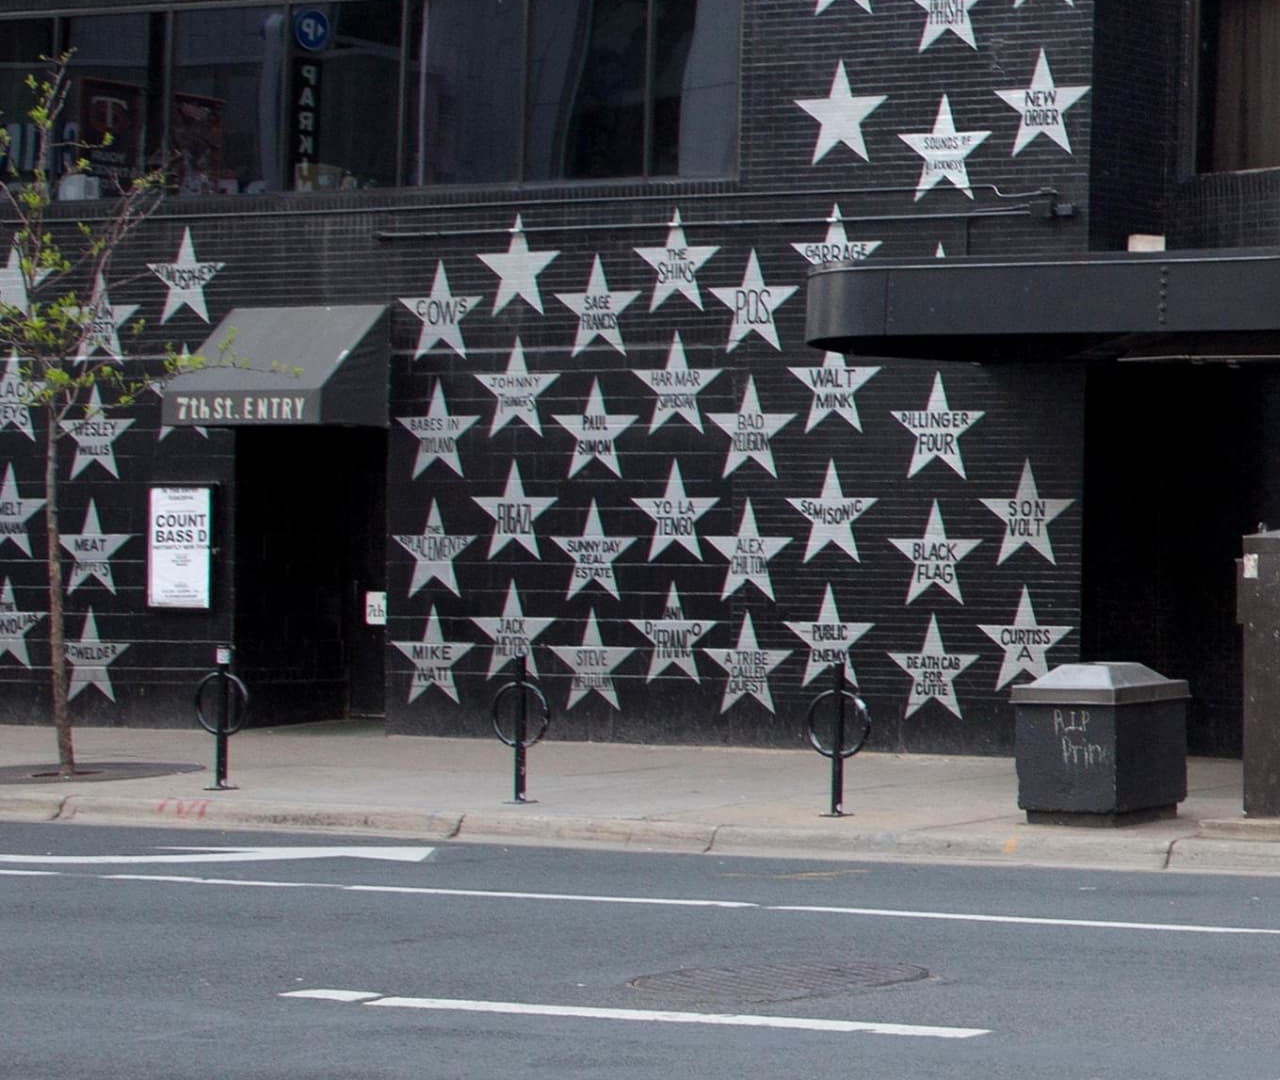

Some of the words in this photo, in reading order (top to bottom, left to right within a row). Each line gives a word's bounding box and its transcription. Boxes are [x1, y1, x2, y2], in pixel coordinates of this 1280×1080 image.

[1024, 90, 1057, 108] NEW
[1024, 109, 1059, 127] ORDER
[666, 248, 688, 262] THE
[657, 261, 697, 285] SHINS
[583, 295, 613, 311] SAGE
[416, 298, 468, 326] COWS
[580, 313, 618, 332] FRANCIS
[489, 375, 542, 389] JOHNNY
[650, 371, 673, 388] HAR
[674, 370, 701, 387] MAR
[809, 368, 857, 388] WALT
[176, 397, 211, 420] 7th
[213, 397, 240, 420] St.
[243, 397, 305, 420] ENTRY
[815, 394, 853, 410] MINK
[0, 405, 30, 427] EYS
[409, 417, 444, 432] BABES
[447, 417, 460, 431] IN
[581, 415, 606, 432] PAUL
[736, 413, 765, 431] BAD
[901, 411, 970, 429] DILLINGER
[72, 421, 118, 438] WESLEY
[577, 439, 613, 457] SIMON
[918, 433, 956, 455] FOUR
[653, 501, 672, 515] YO
[678, 501, 696, 515] LA
[800, 499, 864, 526] SEMISONIC
[1008, 500, 1046, 518] SON
[155, 514, 207, 529] COUNT
[656, 517, 694, 537] TENGO
[1008, 518, 1045, 538] VOLT
[155, 529, 194, 544] BASS
[198, 529, 208, 543] D
[75, 538, 108, 553] MEAT
[567, 539, 600, 555] SUNNY
[602, 539, 622, 555] DAY
[735, 538, 765, 554] ALEX
[912, 542, 957, 562] BLACK
[580, 553, 606, 565] REAL
[731, 557, 768, 576] CHILTON
[575, 566, 613, 580] ESTATE
[917, 562, 954, 584] FLAG
[496, 620, 526, 636] JACK
[811, 623, 849, 641] PUBLIC
[1000, 629, 1051, 647] CURTISS
[412, 644, 453, 660] MIKE
[575, 649, 609, 667] STEVE
[724, 653, 734, 667] A
[735, 651, 769, 666] TRIBE
[811, 649, 849, 664] ENEMY
[1016, 646, 1034, 662] A
[906, 656, 940, 672] DEATH
[941, 657, 961, 672] CAB
[416, 666, 450, 683] WATT
[731, 666, 767, 680] CALLED
[923, 671, 943, 683] FOR
[729, 680, 767, 696] QUEST
[915, 683, 949, 697] CUTIE
